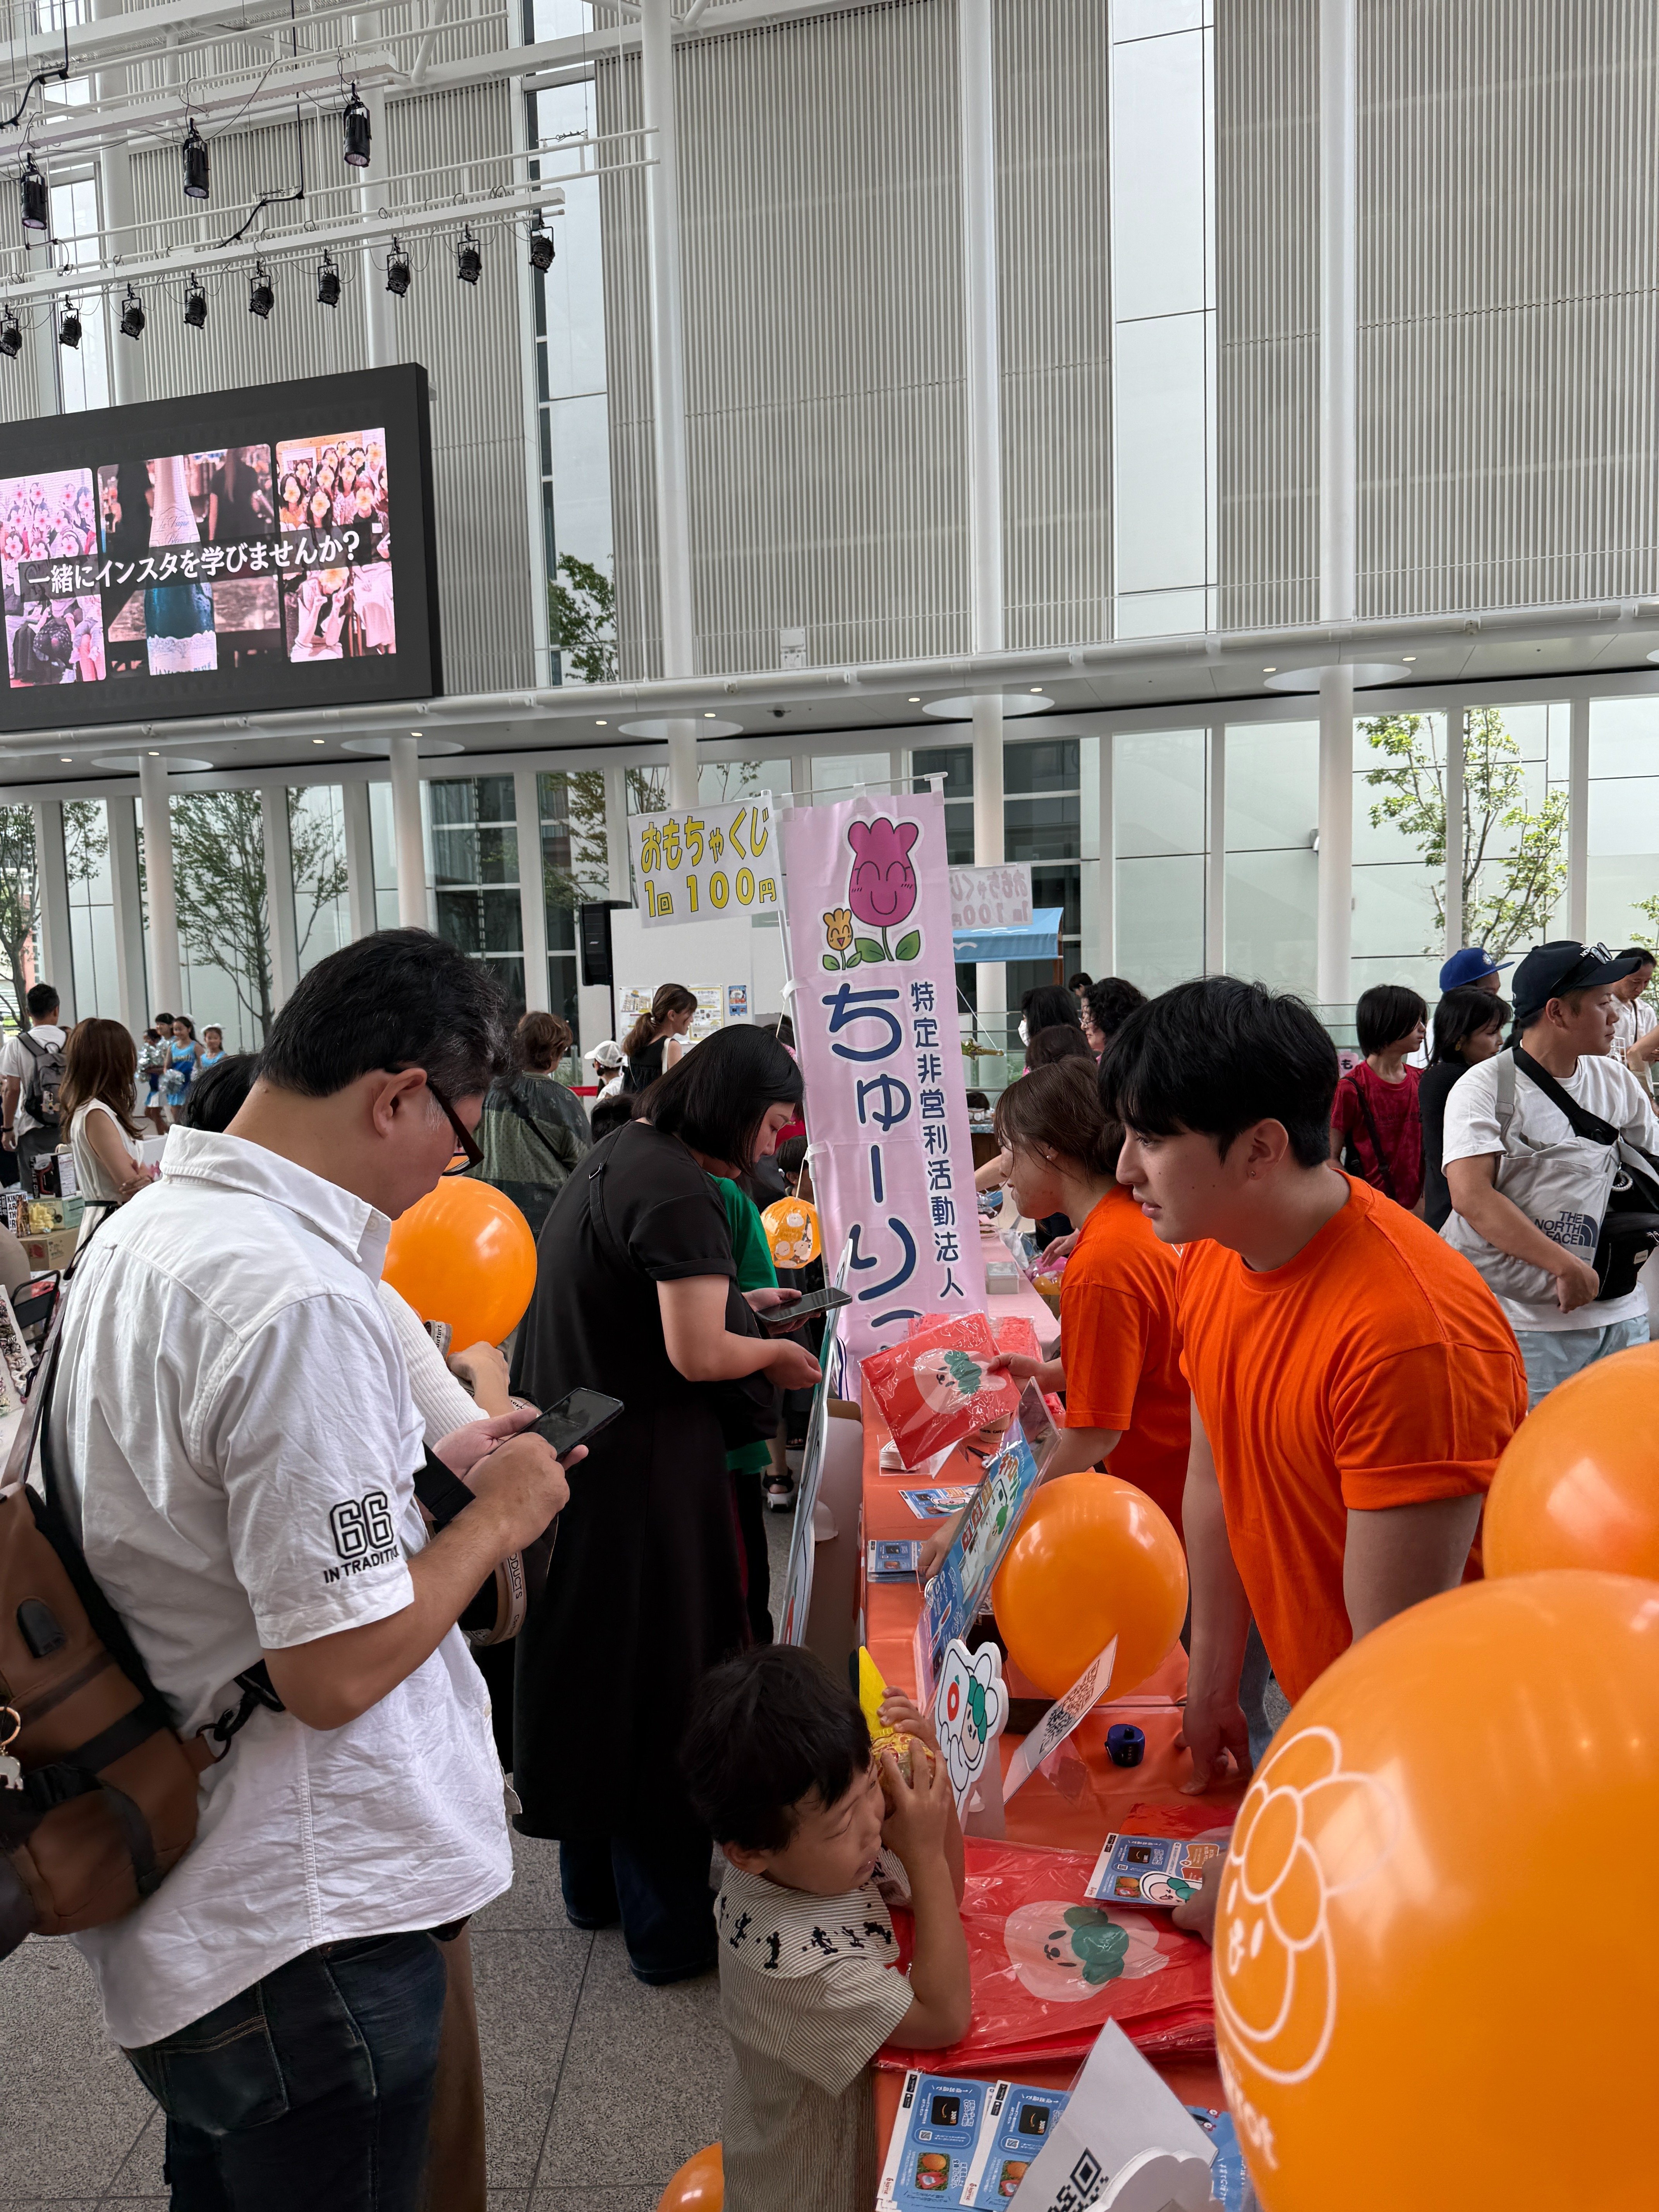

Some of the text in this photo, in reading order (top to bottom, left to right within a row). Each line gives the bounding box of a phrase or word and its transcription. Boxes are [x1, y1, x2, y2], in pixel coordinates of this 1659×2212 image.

[28, 531, 360, 594] 一緒にインスタを学びませんか？
[641, 807, 769, 874] おもちゃくじ
[644, 867, 776, 918] 1回 100円
[911, 981, 964, 1298] 特定非営利活動法人
[1534, 1219, 1582, 1234] NORTH
[1546, 1231, 1579, 1245] FACE
[1560, 1211, 1583, 1223] THE
[330, 1491, 394, 1560] 66
[323, 1567, 340, 1583] IN
[508, 1552, 523, 1600] ODUCTS
